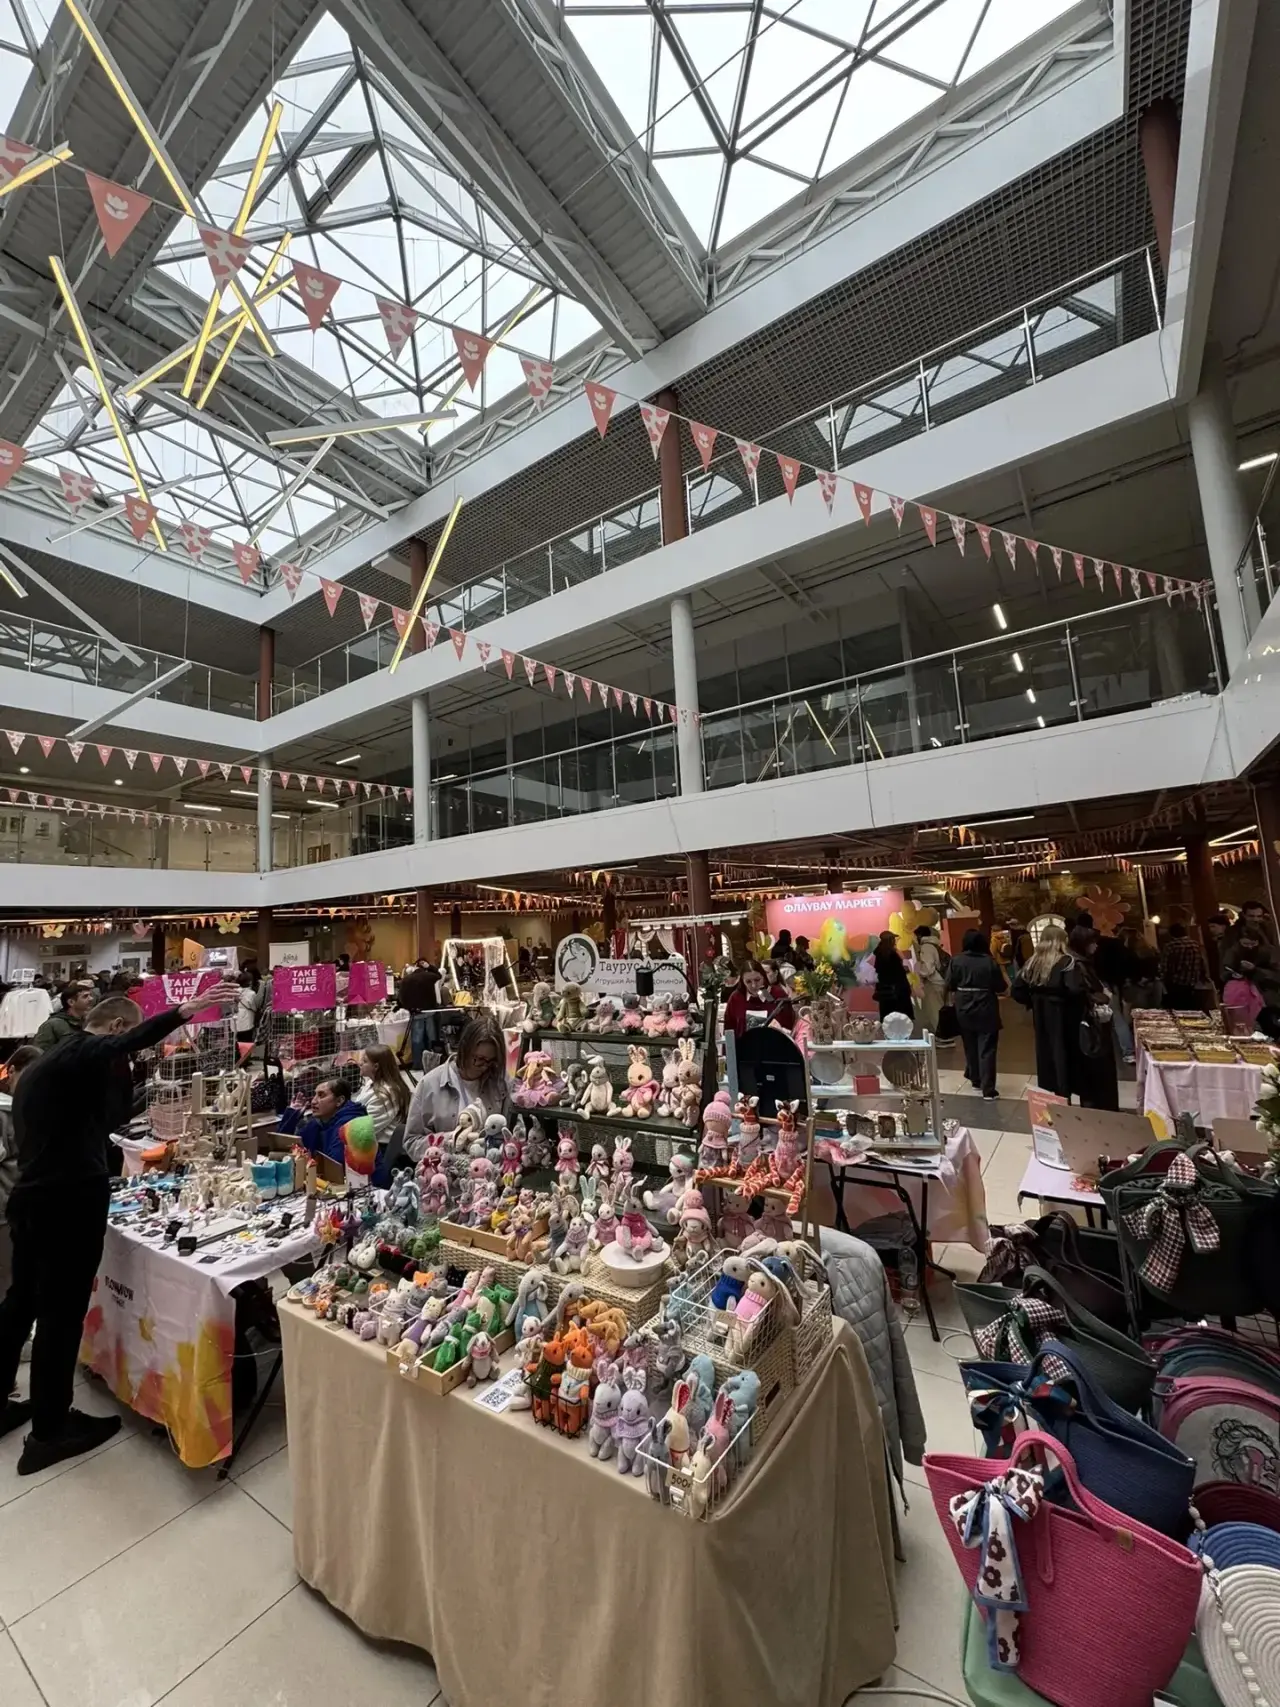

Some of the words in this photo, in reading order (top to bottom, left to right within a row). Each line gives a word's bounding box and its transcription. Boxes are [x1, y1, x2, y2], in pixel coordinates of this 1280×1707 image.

[783, 901, 832, 913] ФЛАУВАУ
[835, 897, 882, 910] МАРКЕТ
[292, 968, 317, 977] TAKE
[292, 976, 317, 985] THE
[291, 984, 317, 993] BAG
